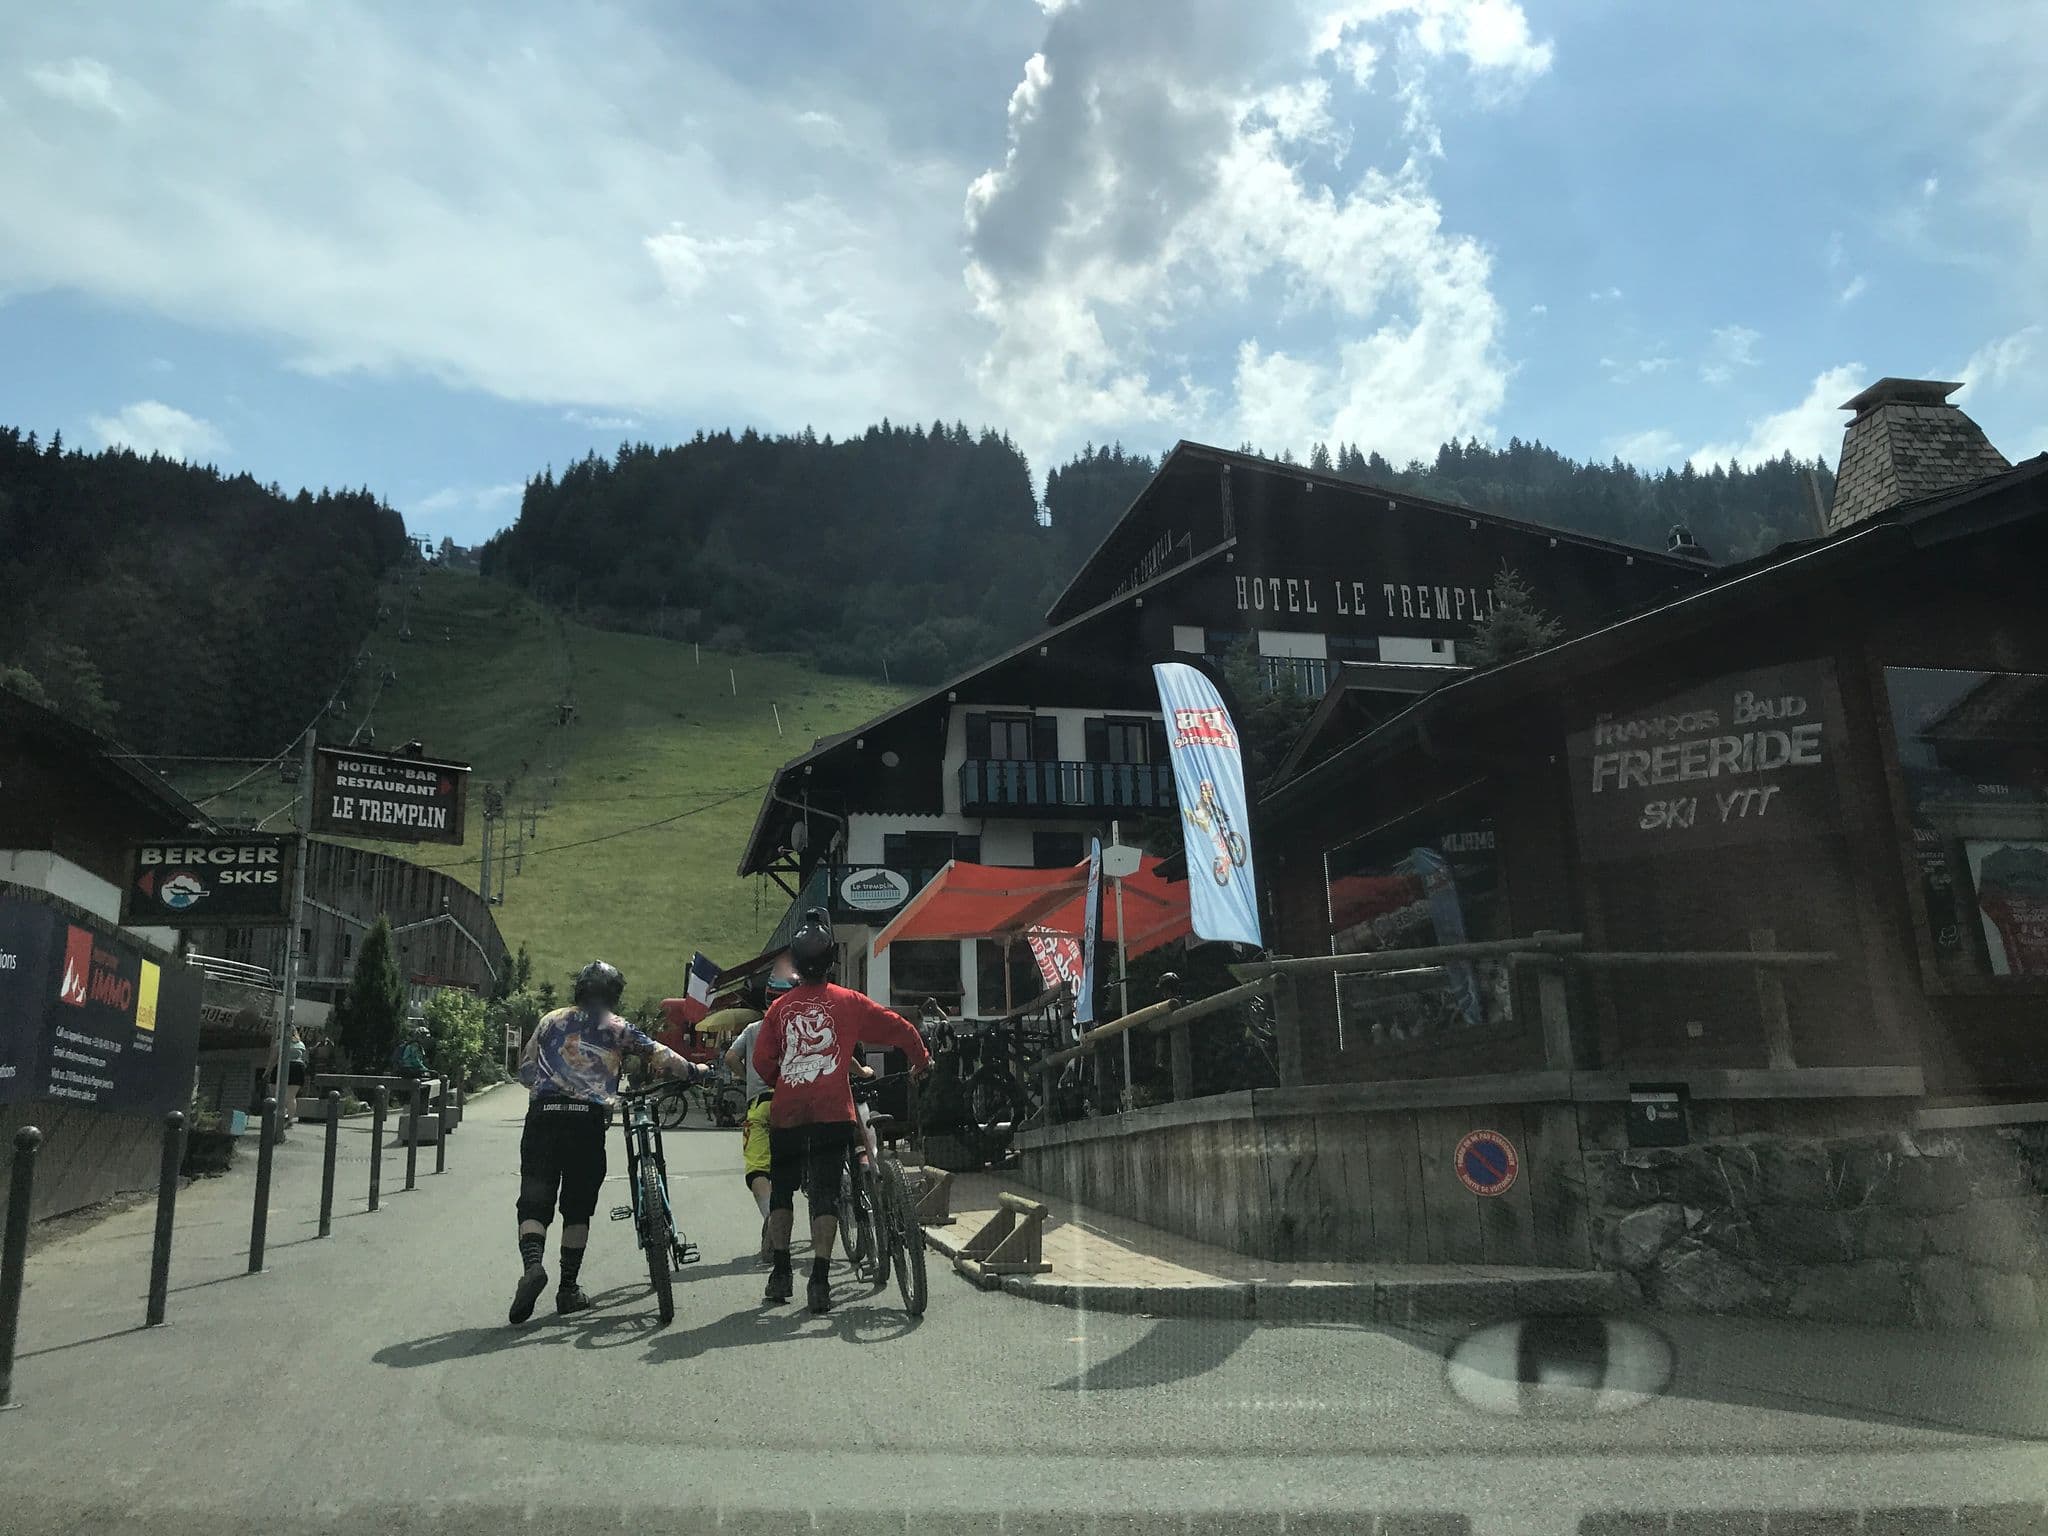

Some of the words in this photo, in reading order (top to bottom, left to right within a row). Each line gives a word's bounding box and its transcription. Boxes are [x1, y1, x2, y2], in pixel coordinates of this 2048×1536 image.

[1235, 576, 1318, 613] HOTEL
[1335, 581, 1366, 616] LE
[1383, 584, 1506, 622] TREMPLI
[337, 760, 386, 776] HOTEL
[405, 769, 437, 783] BAR
[1592, 723, 1823, 793] FREERIDE
[337, 775, 437, 797] RESTAURANT
[331, 795, 354, 819] LE
[358, 798, 447, 830] TREMPLIN
[1639, 797, 1698, 830] SKI
[140, 846, 281, 865] BERGER
[218, 870, 279, 884] SKIS
